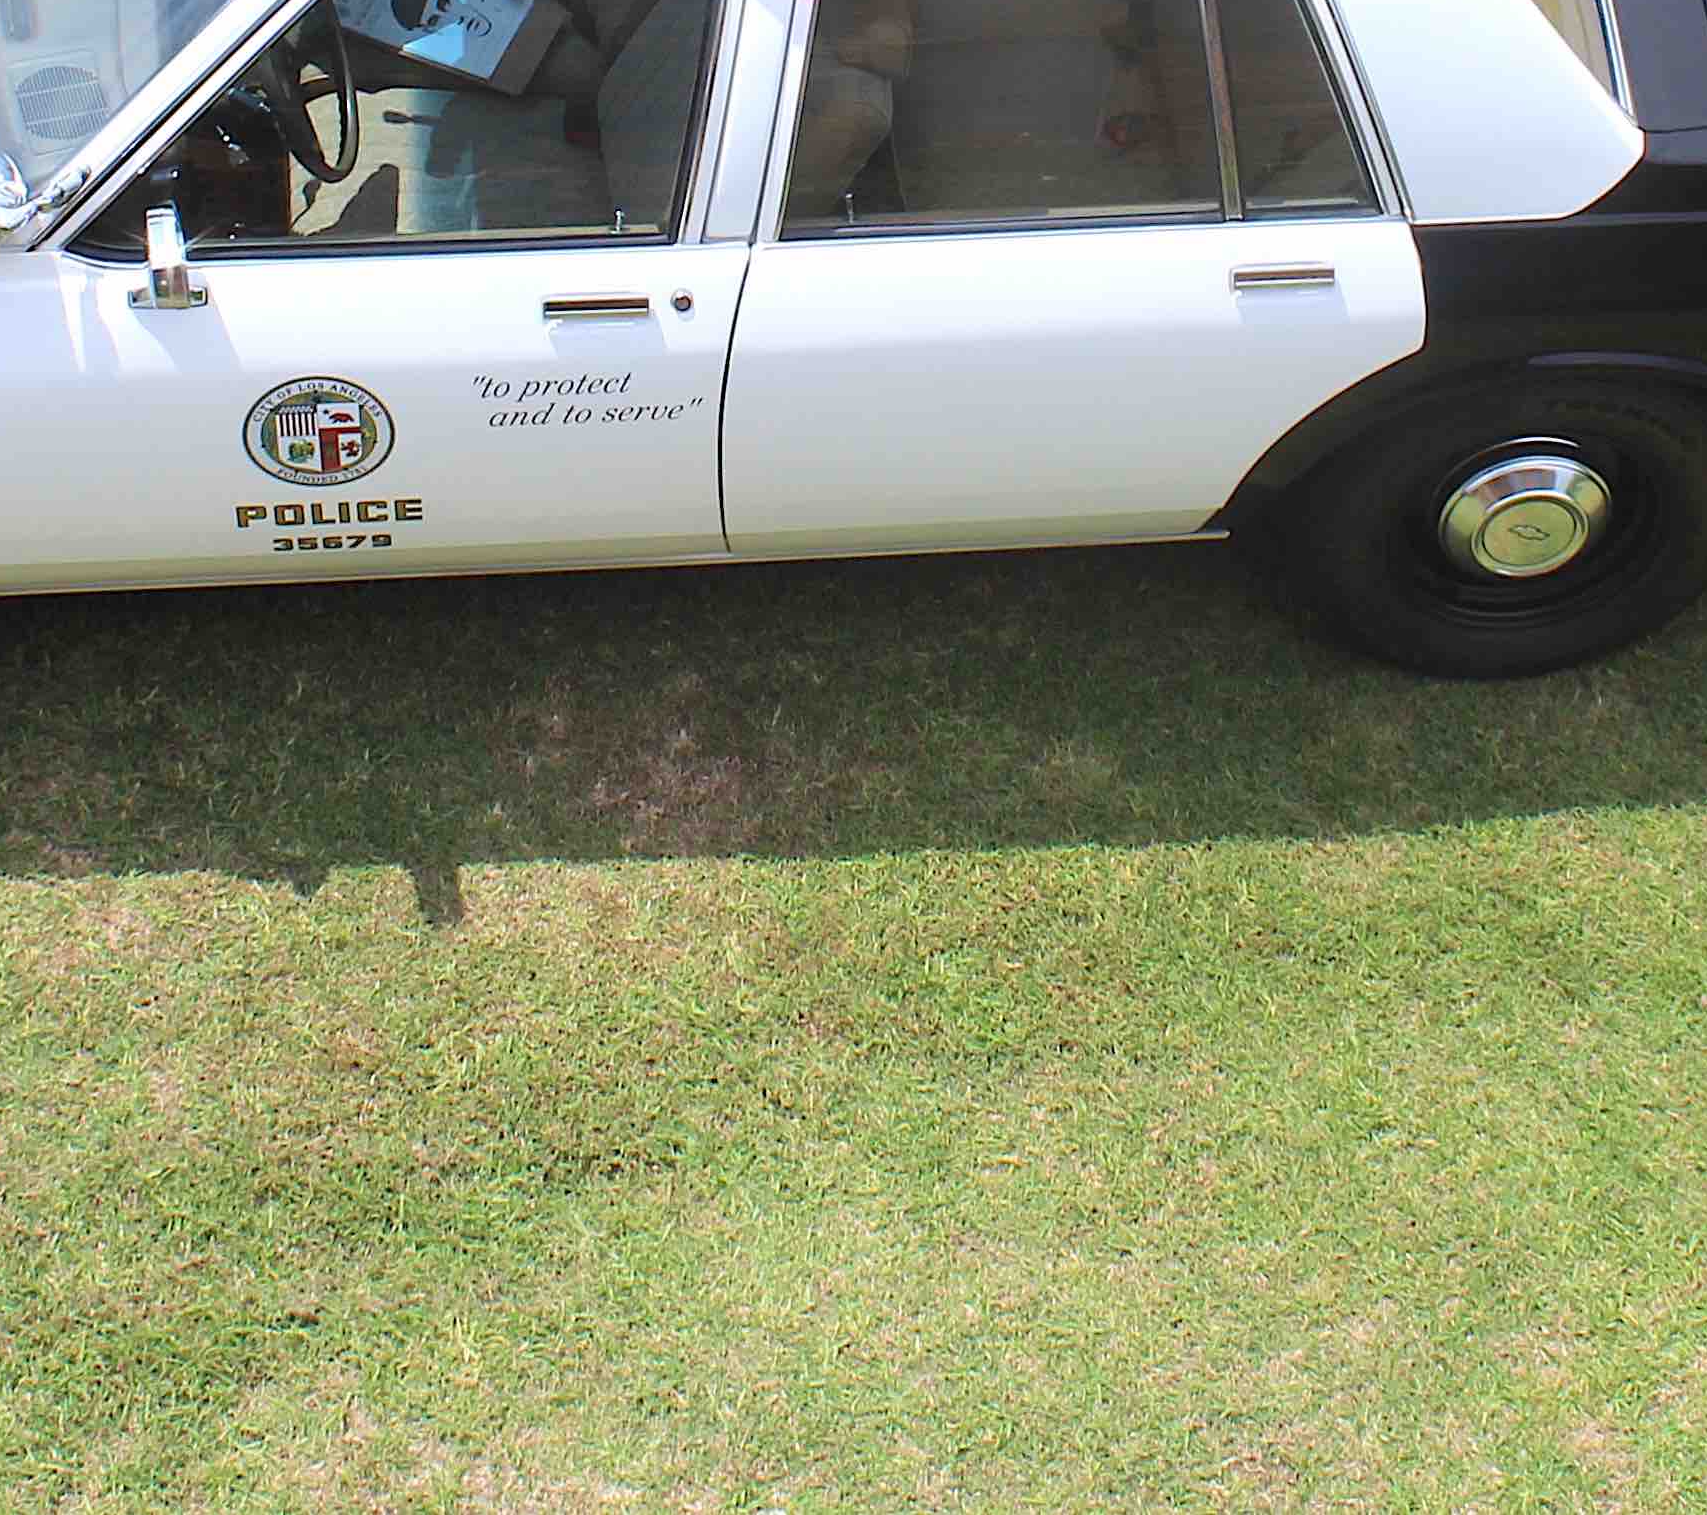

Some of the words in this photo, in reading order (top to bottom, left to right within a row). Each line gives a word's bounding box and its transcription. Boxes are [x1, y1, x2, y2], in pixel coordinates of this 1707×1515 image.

[253, 398, 275, 422] CITY
[277, 386, 293, 399] OF
[299, 382, 324, 392] LOS
[331, 384, 382, 418] ANGELES
[472, 375, 510, 399] "to
[517, 372, 632, 403] protect
[489, 402, 556, 427] and
[562, 405, 593, 425] to
[601, 396, 703, 423] serve"
[236, 498, 423, 528] POLICE
[273, 534, 392, 551] 35679
